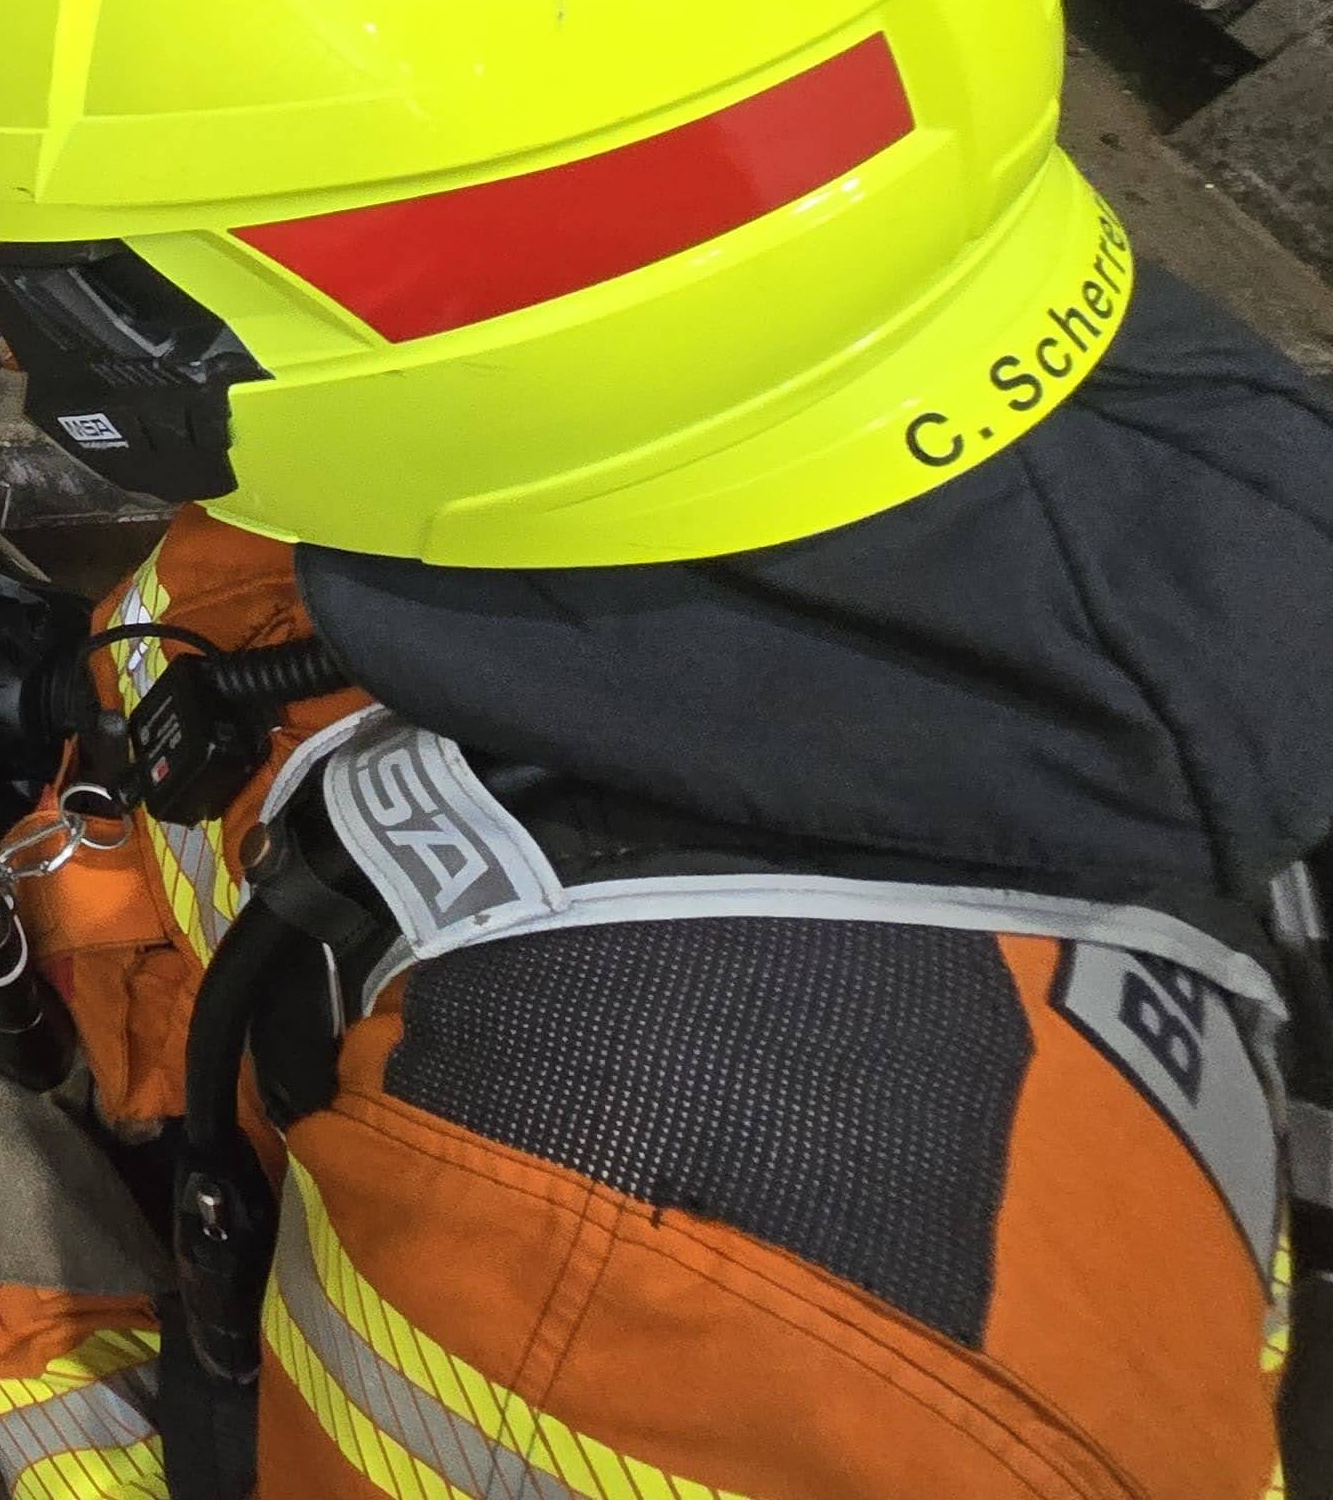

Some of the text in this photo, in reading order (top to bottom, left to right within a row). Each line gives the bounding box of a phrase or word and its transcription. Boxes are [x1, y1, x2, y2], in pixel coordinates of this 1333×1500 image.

[905, 197, 1127, 467] C. Scherre
[356, 730, 489, 912] SA
